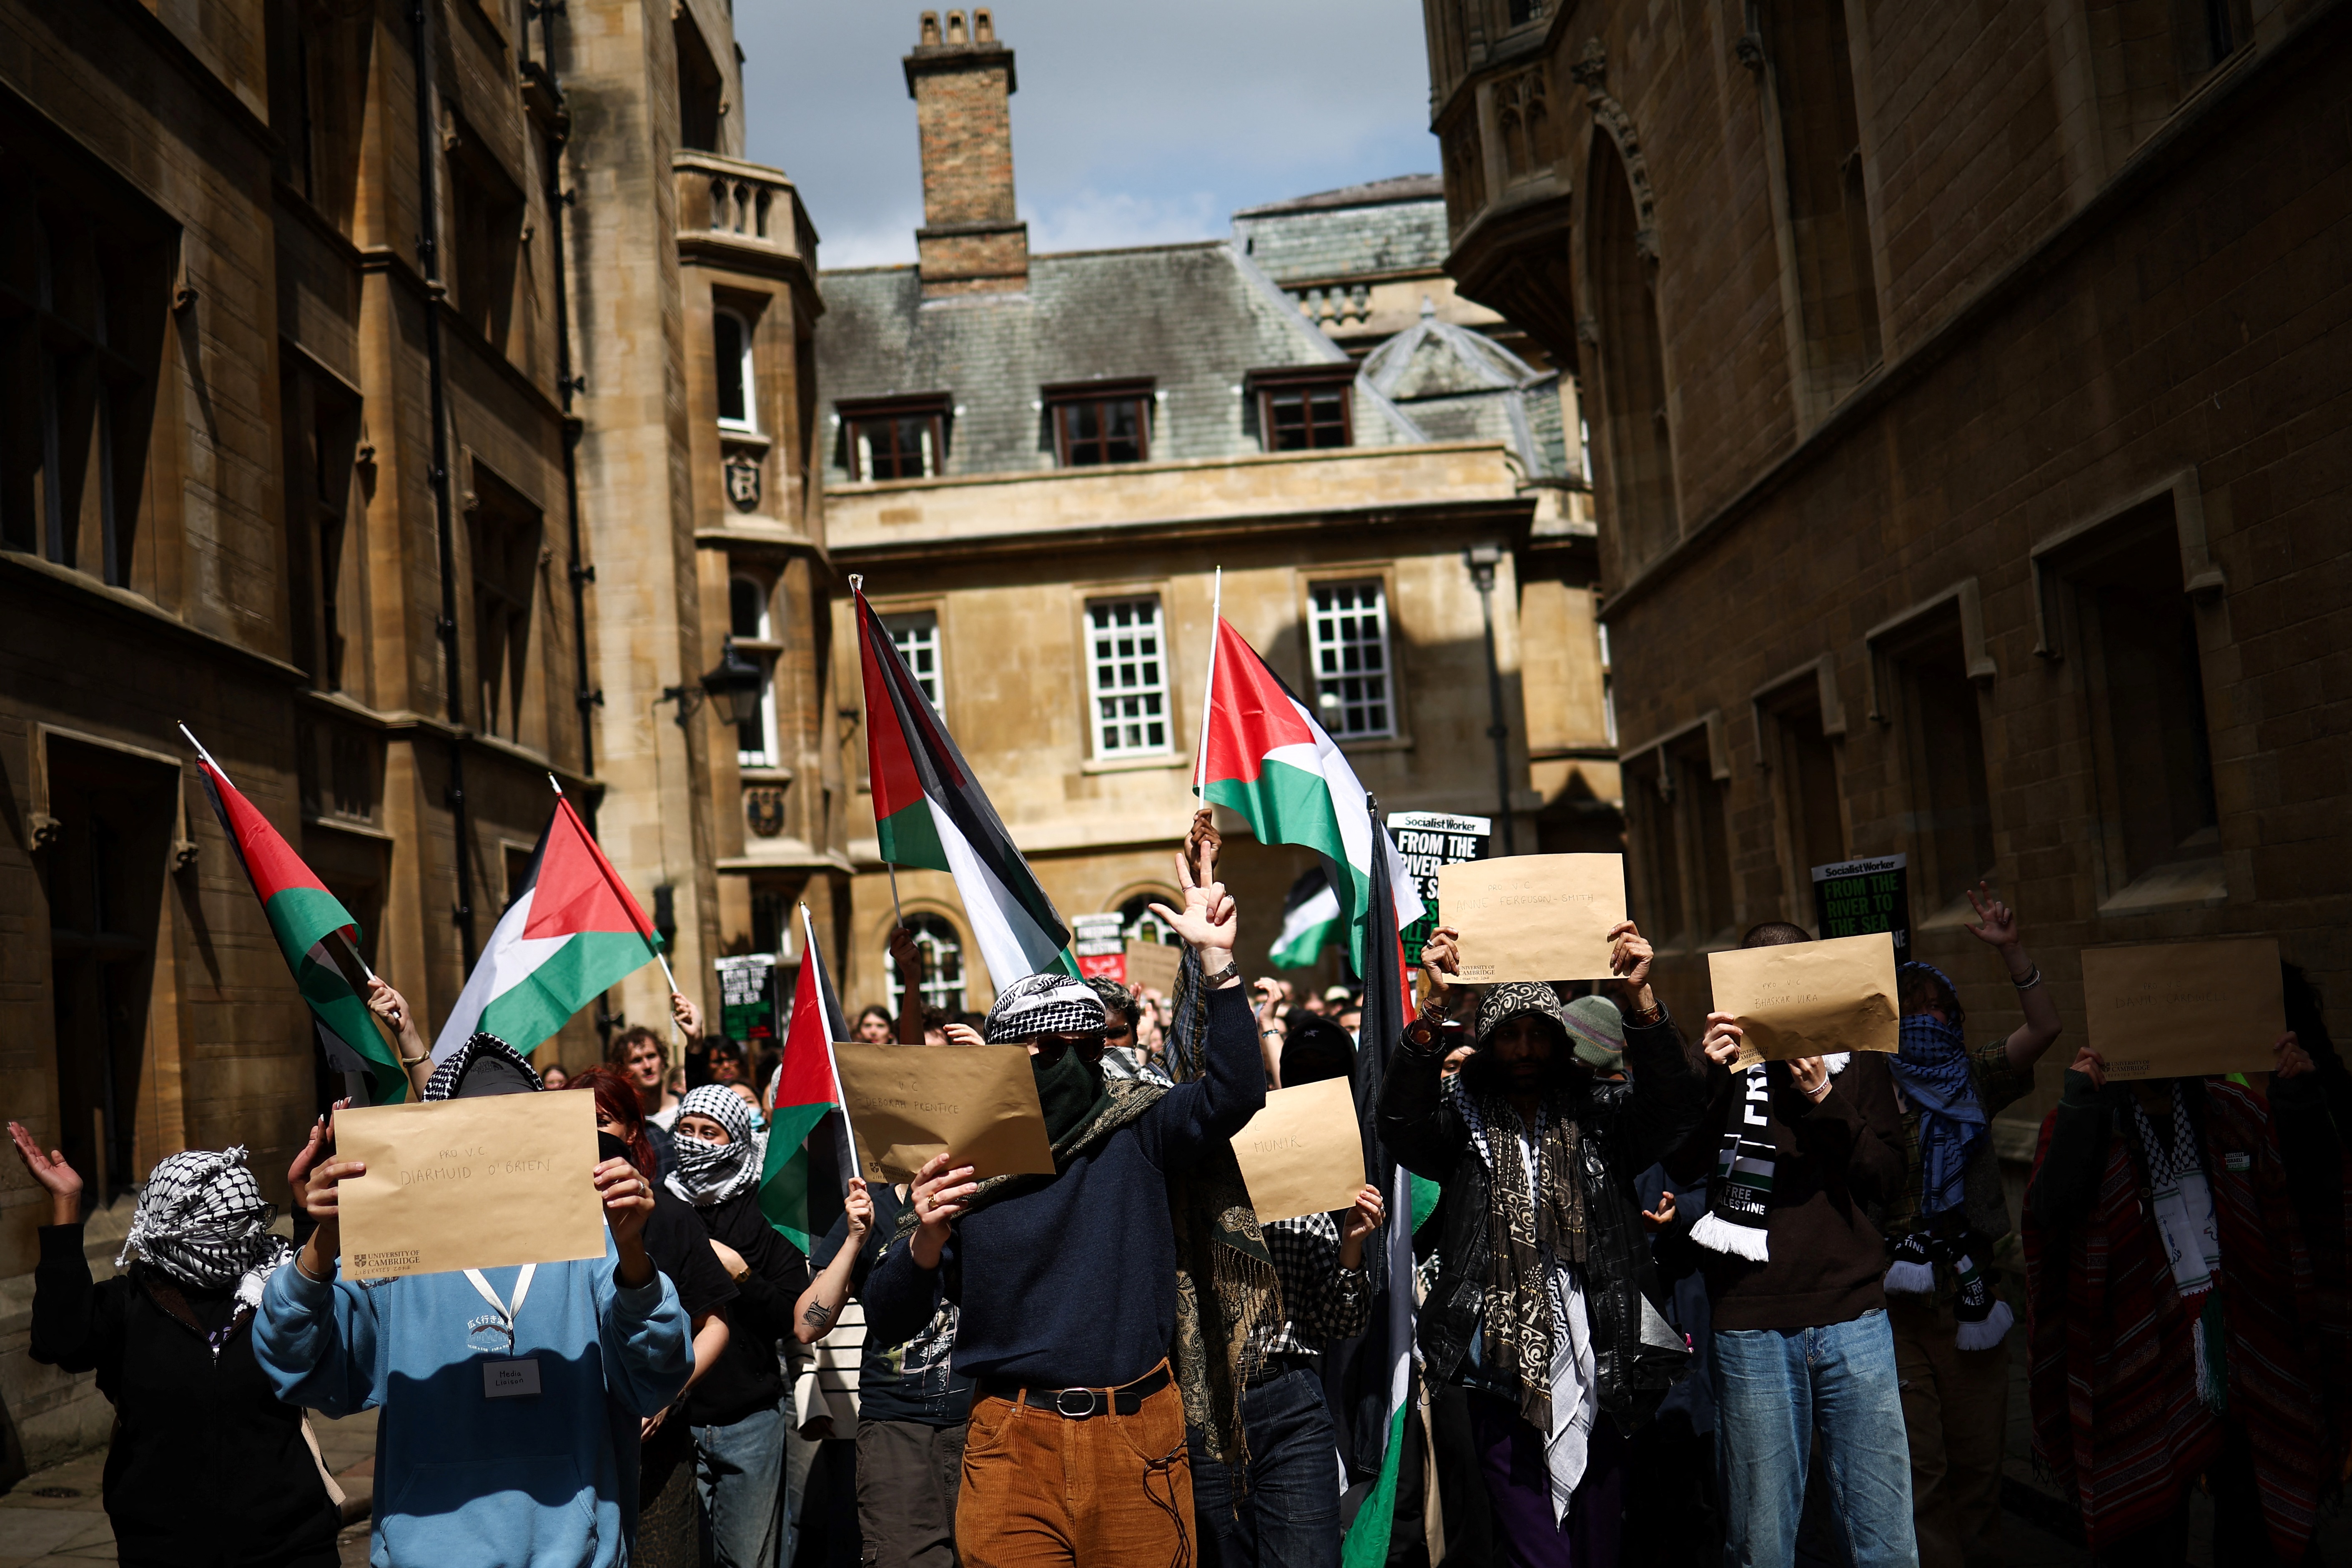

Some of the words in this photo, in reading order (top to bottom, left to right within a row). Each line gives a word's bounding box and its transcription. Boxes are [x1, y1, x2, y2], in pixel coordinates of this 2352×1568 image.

[1405, 816, 1445, 829] Socialist
[1446, 819, 1476, 831] Worker
[1398, 830, 1444, 855] FROM
[1448, 835, 1477, 858] THE
[1825, 863, 1863, 877] Socialist
[1863, 860, 1895, 871] Worker
[1824, 878, 1866, 900] FROM
[1870, 873, 1898, 893] THE
[1457, 897, 1489, 913] ANNE
[1827, 897, 1868, 918] RIVER
[1873, 893, 1893, 912] TO
[1828, 918, 1858, 938] THE
[1861, 913, 1890, 934] SEA
[1755, 995, 1790, 1009] BHASKAR
[1798, 994, 1818, 1004] VIRA
[2116, 995, 2157, 1009] DAVID
[2167, 992, 2228, 1004] CARDWELL
[1739, 1047, 1762, 1056] NIVERSITY
[866, 1097, 906, 1109] DEBORAH
[914, 1101, 959, 1114] PRENTICE
[1254, 1135, 1301, 1153] MUNIR
[440, 1149, 457, 1159] PRO
[401, 1167, 471, 1185] DIARMUID
[1726, 1184, 1752, 1201] FREE
[1718, 1194, 1766, 1216] ALESTINE
[368, 1250, 410, 1259] UNIVERSITY
[369, 1256, 420, 1267] CAMBRIDGE
[355, 1267, 390, 1275] LIBERATED
[496, 1378, 524, 1386] Liaison
